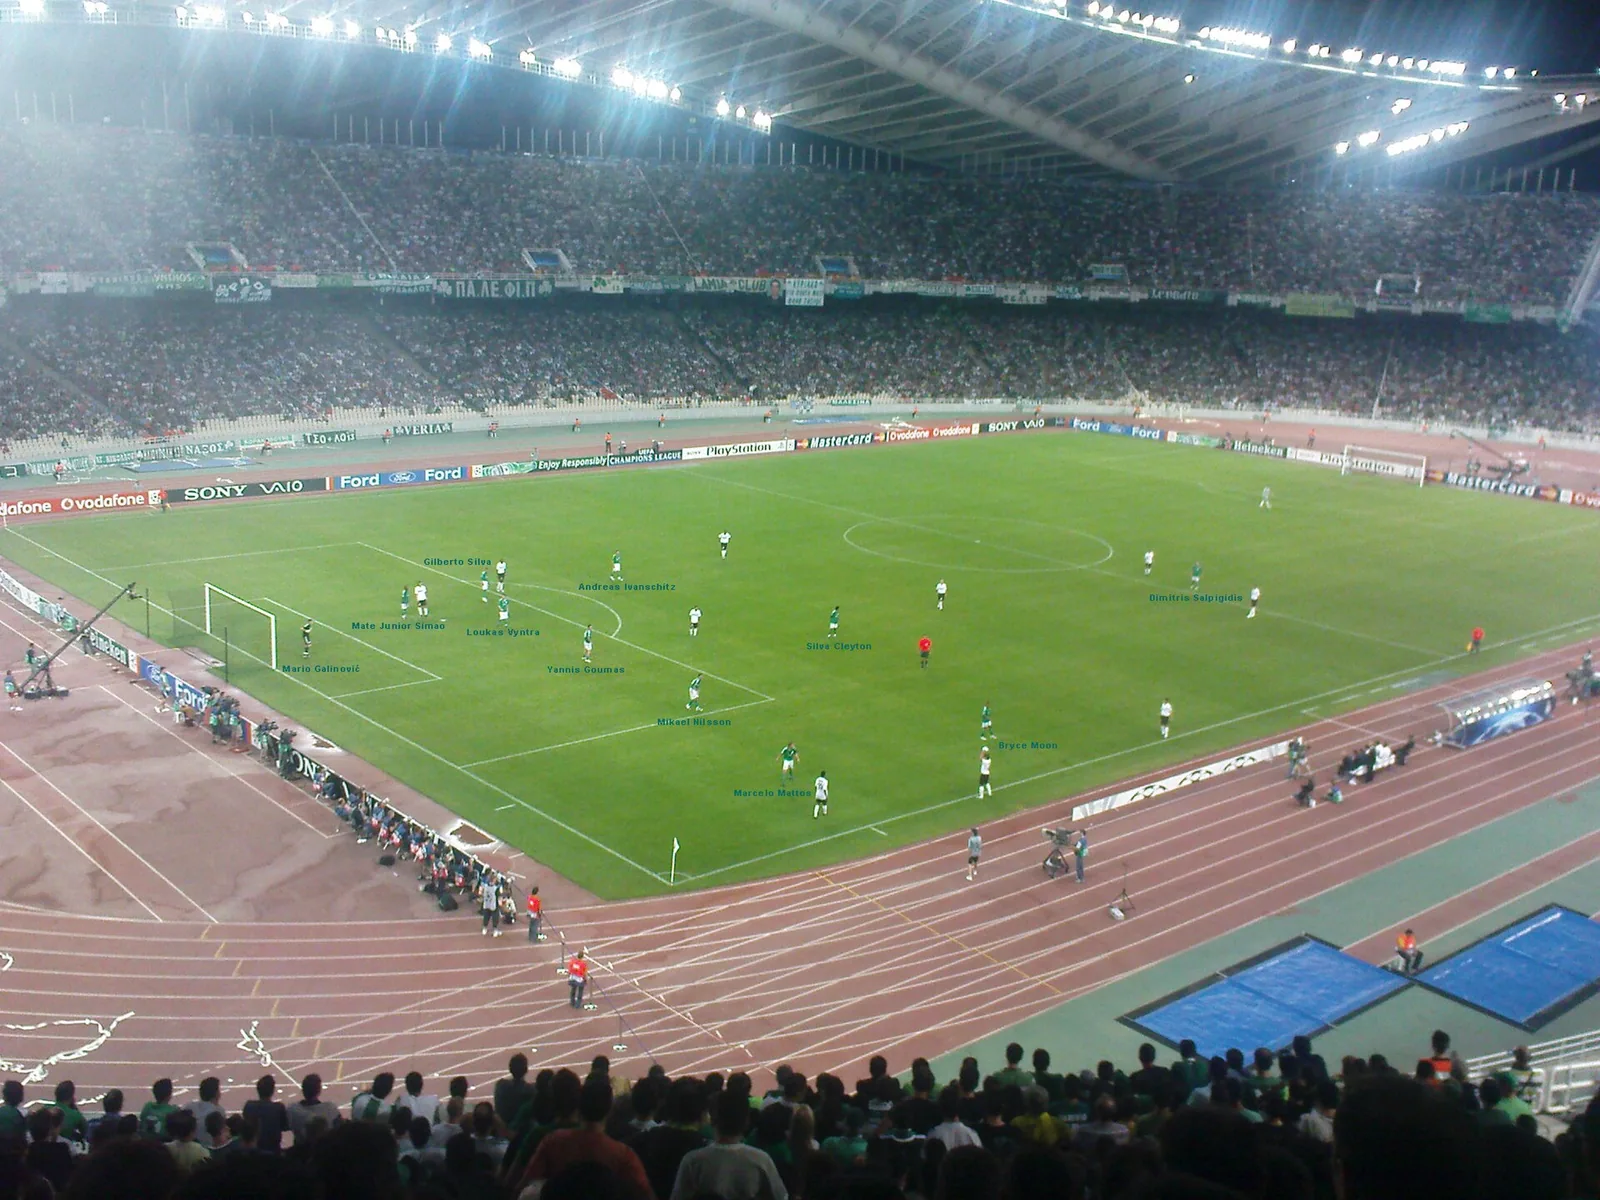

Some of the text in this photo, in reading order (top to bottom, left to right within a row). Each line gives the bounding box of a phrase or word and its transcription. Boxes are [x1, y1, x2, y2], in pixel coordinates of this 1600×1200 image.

[738, 278, 767, 292] CLUB
[403, 423, 443, 436] VERIA
[939, 425, 971, 437] vodafone
[988, 418, 1046, 433] SONY VAIO
[1073, 417, 1100, 432] Ford
[810, 432, 872, 449] MasterCard
[896, 428, 930, 441] vodafone
[1131, 426, 1160, 440] Ford
[706, 442, 772, 457] PlayStation
[1233, 440, 1284, 457] Heineken
[538, 455, 608, 472] Enjoy Responsibly
[609, 451, 682, 466] CHAMPIONS LEAGUE
[340, 473, 380, 489] Ford
[424, 467, 462, 481] Ford
[184, 480, 304, 501] SONY VAIO
[1447, 472, 1536, 497] MasterCard
[75, 493, 145, 511] vodafone
[89, 630, 128, 664] eineken
